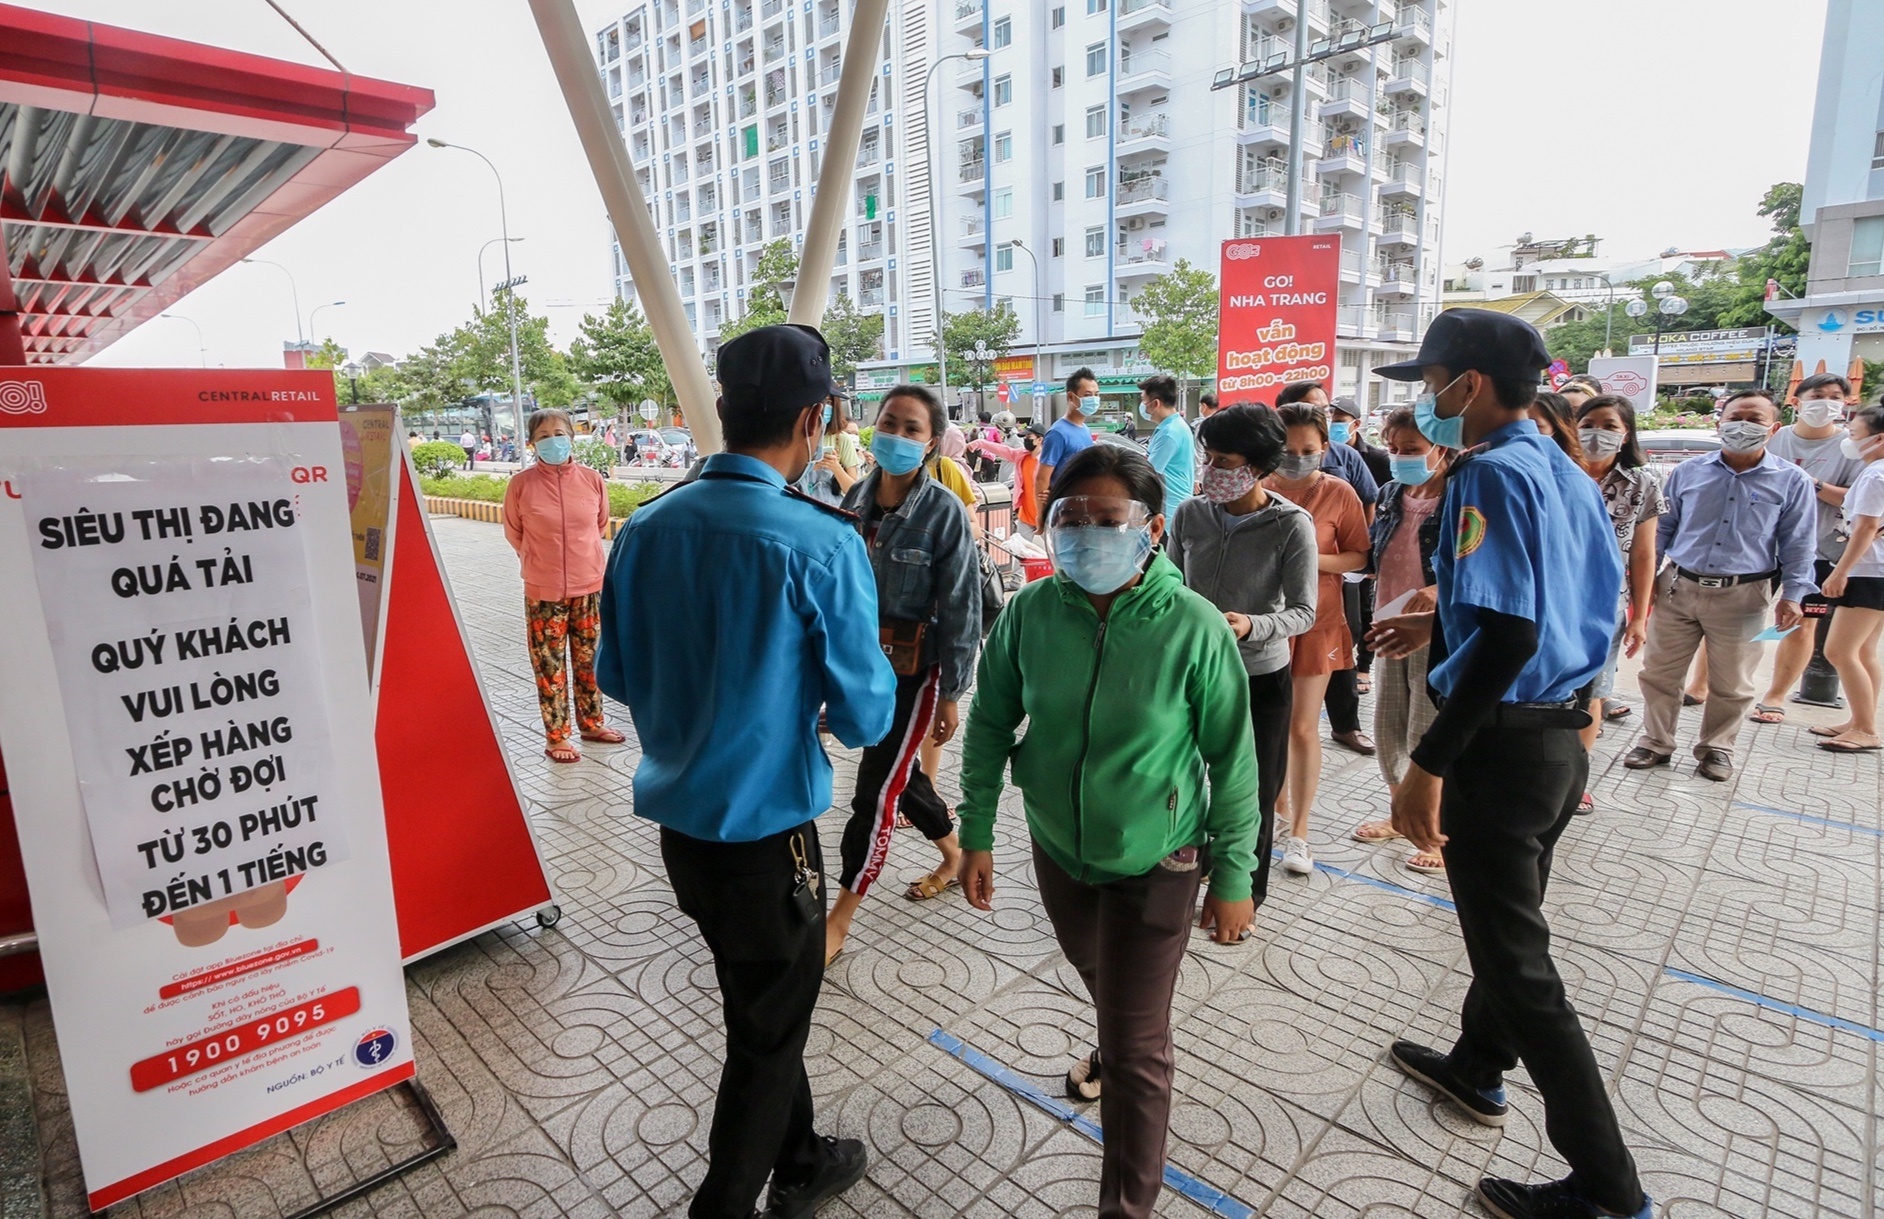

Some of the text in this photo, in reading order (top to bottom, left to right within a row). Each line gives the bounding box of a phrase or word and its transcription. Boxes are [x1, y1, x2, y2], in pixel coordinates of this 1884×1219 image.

[1229, 292, 1327, 308] NHA TRANG
[1263, 275, 1294, 289] GO!
[1257, 319, 1295, 342] vẫn
[1647, 330, 1748, 344] MOKA COFFEE
[1227, 343, 1324, 369] hoạt động
[1221, 378, 1237, 391] từ
[1239, 374, 1275, 388] 8h00
[1284, 367, 1328, 382] 22h00
[363, 419, 390, 430] CENTRAL
[290, 466, 328, 484] QR
[38, 499, 295, 550] SIÊU THỊ ĐANG
[111, 546, 254, 599] QUÁ TẢI
[91, 617, 291, 673] QUÝ KHÁCH
[120, 669, 280, 723] VUI LÒNG
[125, 716, 293, 777] XẾP HÀNG
[151, 753, 286, 813] CHỜ ĐỢI
[137, 795, 319, 869] TỪ 30 PHÚT
[864, 825, 891, 880] TOMMY
[141, 841, 327, 918] ĐẾN 1 TIẾNG
[143, 1004, 156, 1014] để
[158, 998, 180, 1010] được
[183, 990, 205, 1002] cảnh
[207, 984, 224, 994] báo
[225, 976, 246, 987] nguy
[260, 967, 273, 976] lây
[274, 959, 298, 971] nhiễm
[300, 946, 335, 962] Covid-19
[172, 971, 188, 981] Cài
[189, 966, 204, 976] đặt
[206, 961, 223, 970] app
[225, 947, 262, 964] Bluezone
[263, 944, 274, 952] tại
[275, 940, 288, 948] địa
[181, 947, 302, 990] https:// www.bluezone.gov.vn
[208, 988, 286, 1022] SỐT, HO, KHÓ THỞ
[212, 982, 280, 1010] Khi có dấu hiệu
[166, 1037, 184, 1047] hãy
[186, 1030, 202, 1041] gọi
[235, 1013, 253, 1023] dây
[254, 1004, 277, 1016] nóng
[279, 998, 295, 1007] của
[296, 993, 308, 1001] Bộ
[168, 1003, 325, 1073] 1900 9095
[167, 1080, 193, 1093] Hoặc
[209, 1065, 233, 1078] quan
[235, 1062, 240, 1070] y
[242, 1055, 252, 1065] tế
[252, 1051, 267, 1061] địa
[268, 1039, 301, 1057] phương
[302, 1031, 314, 1042] để
[315, 1026, 337, 1037] được
[220, 1073, 238, 1084] dẫn
[239, 1062, 265, 1077] khám
[266, 1053, 288, 1067] bệnh
[290, 1049, 301, 1058] an
[302, 1041, 322, 1053] toàn
[310, 1064, 325, 1077] BỘ
[326, 1061, 333, 1069] Y
[335, 1053, 346, 1066] TẾ
